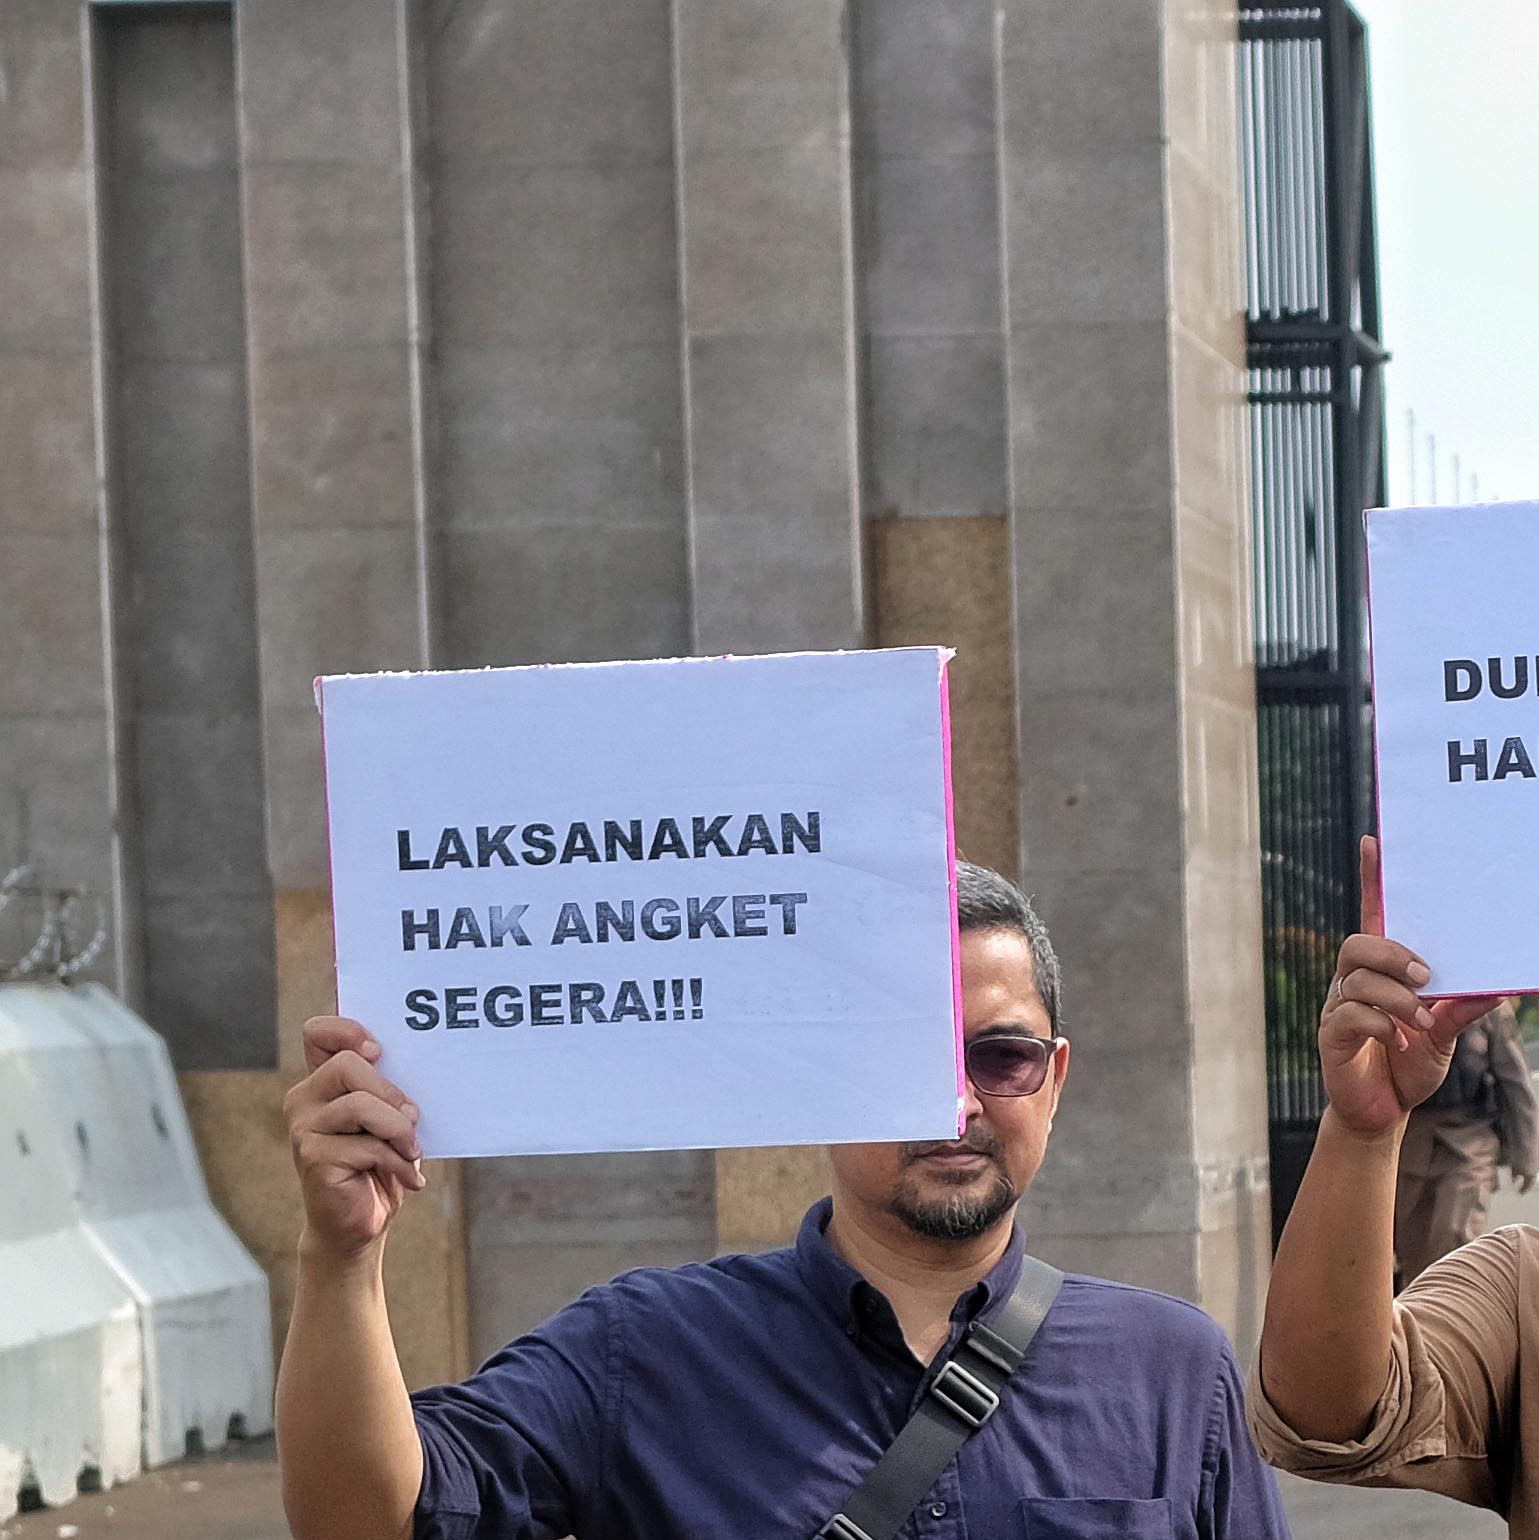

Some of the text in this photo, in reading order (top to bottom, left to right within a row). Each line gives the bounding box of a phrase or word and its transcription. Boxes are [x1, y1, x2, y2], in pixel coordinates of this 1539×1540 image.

[397, 812, 821, 871] LAKSANAKAN
[402, 893, 807, 951] HAK ANGKET
[405, 978, 703, 1031] SEGERA!!!
